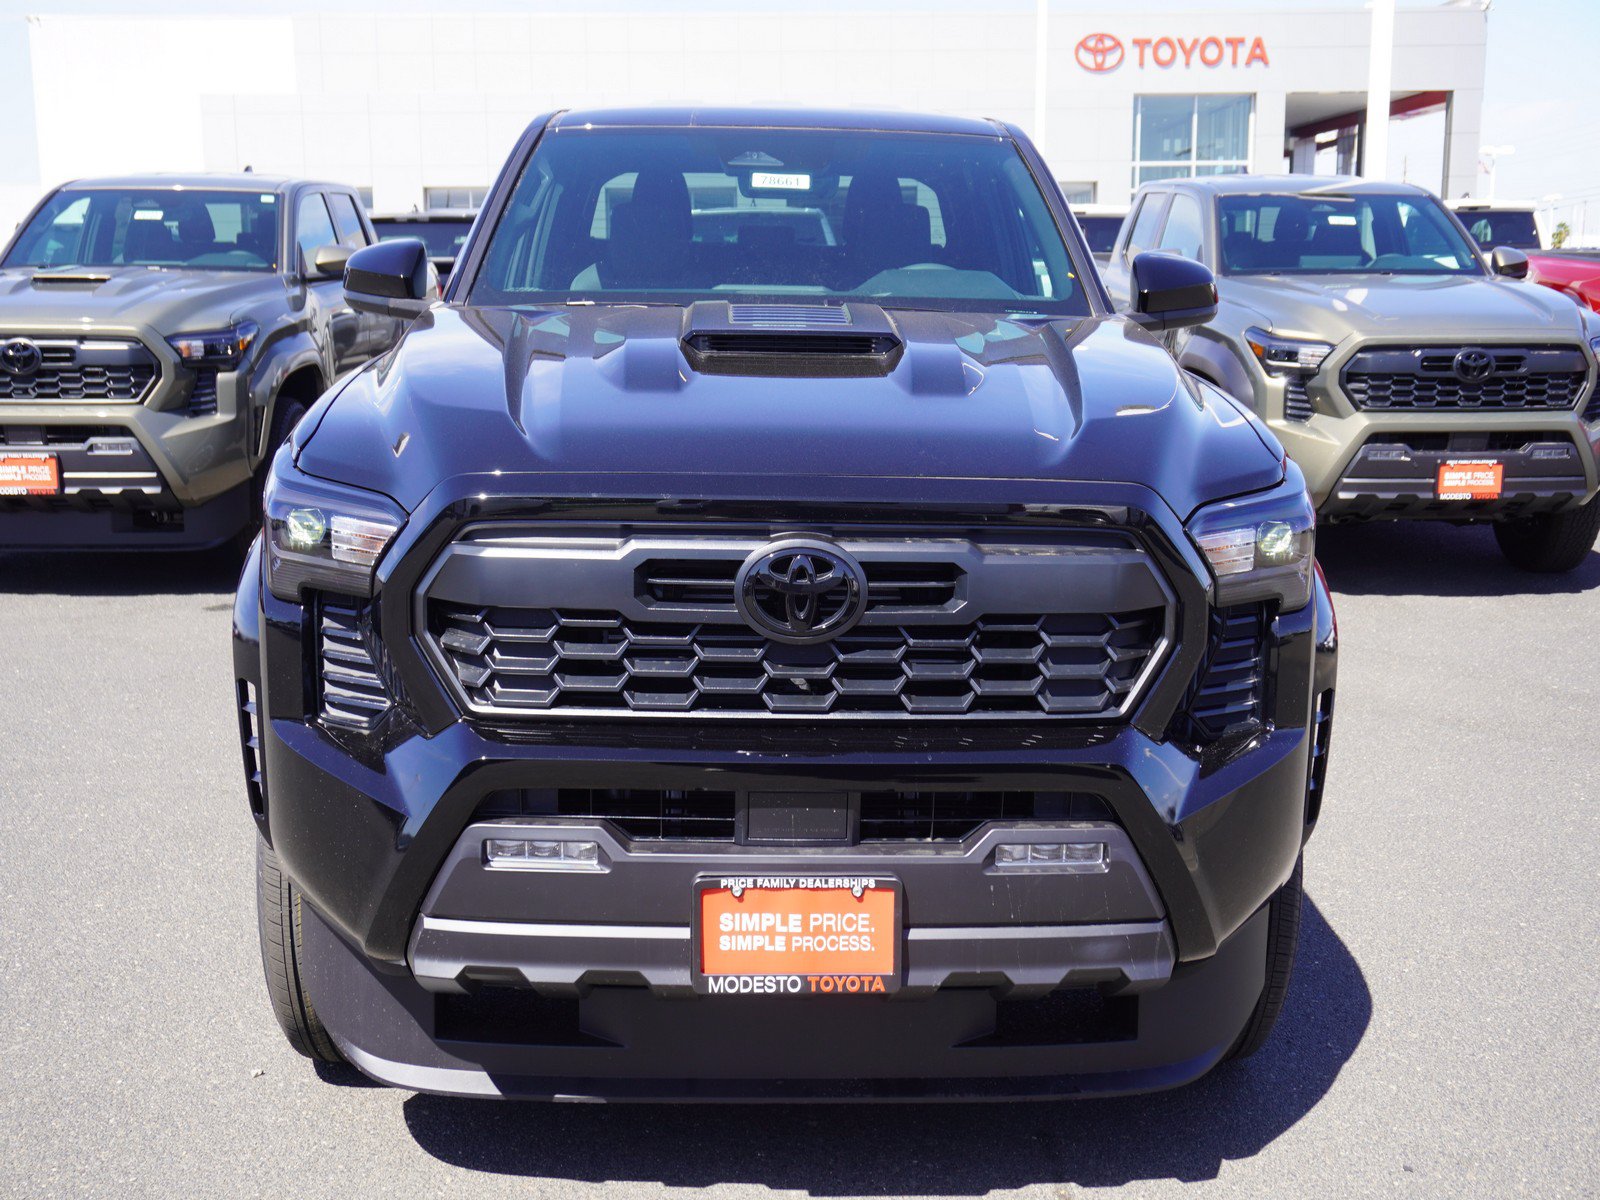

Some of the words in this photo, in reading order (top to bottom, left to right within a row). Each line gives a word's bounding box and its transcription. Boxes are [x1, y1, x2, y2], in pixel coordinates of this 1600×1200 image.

[1132, 36, 1270, 68] TOYOTA
[760, 175, 800, 187] 78661
[0, 465, 26, 473] IMPLE
[0, 487, 27, 495] ODESTO
[720, 878, 754, 889] PRICE
[756, 878, 796, 889] FAMILY
[799, 878, 876, 889] DEALERSHIPS
[719, 912, 802, 933] SIMPLE
[809, 913, 876, 933] PRICE.
[719, 934, 786, 952] SIMPLE
[791, 935, 876, 952] PROCESS.
[708, 975, 802, 994] MODESTO
[807, 975, 886, 993] TOYOTA
